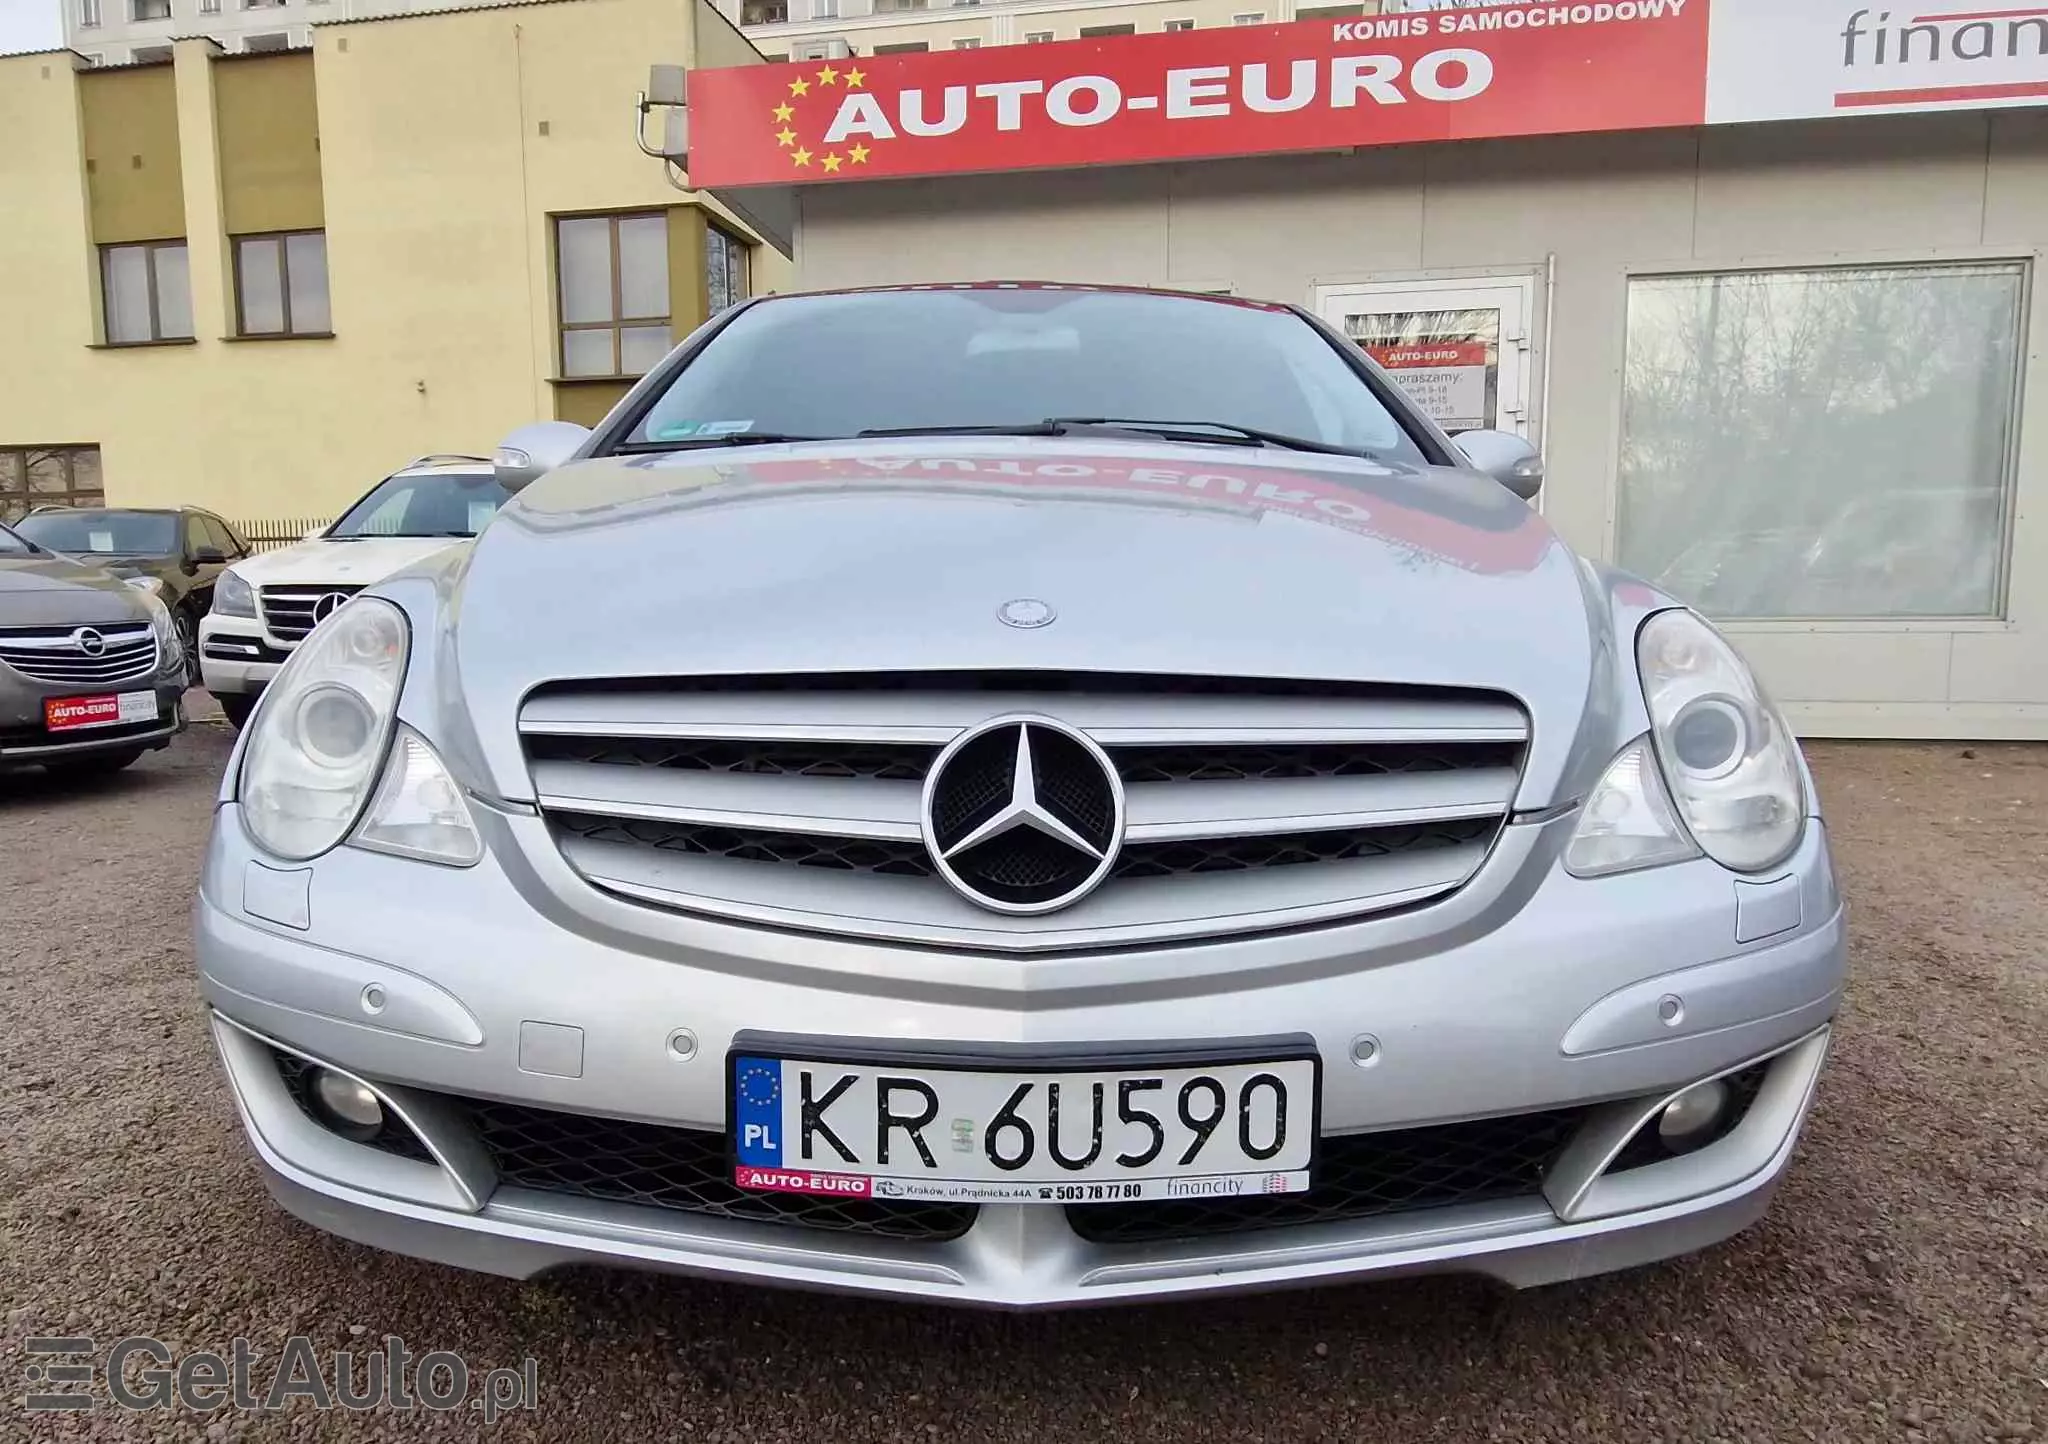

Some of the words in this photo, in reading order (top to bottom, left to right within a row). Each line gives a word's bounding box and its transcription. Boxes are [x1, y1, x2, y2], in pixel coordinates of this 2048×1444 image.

[1333, 18, 1429, 42] KOMIS
[1438, 0, 1686, 34] SAMOCHODOWY
[823, 48, 1494, 144] AUTO-EURO
[1388, 350, 1458, 361] AUTO-EURO
[1392, 372, 1464, 385] praszamy:
[54, 703, 116, 717] AUTO-EURO
[800, 1071, 938, 1168] KR
[984, 1073, 1288, 1171] 6U590
[745, 1124, 776, 1149] PL
[750, 1173, 865, 1192] AUTO-EURO
[906, 1185, 946, 1197] Kraków,
[1013, 1188, 1032, 1197] 44A
[1056, 1185, 1084, 1199] 503
[1087, 1185, 1103, 1199] 78
[1106, 1184, 1120, 1198] 77
[1123, 1183, 1141, 1198] 80
[1167, 1176, 1244, 1196] financity
